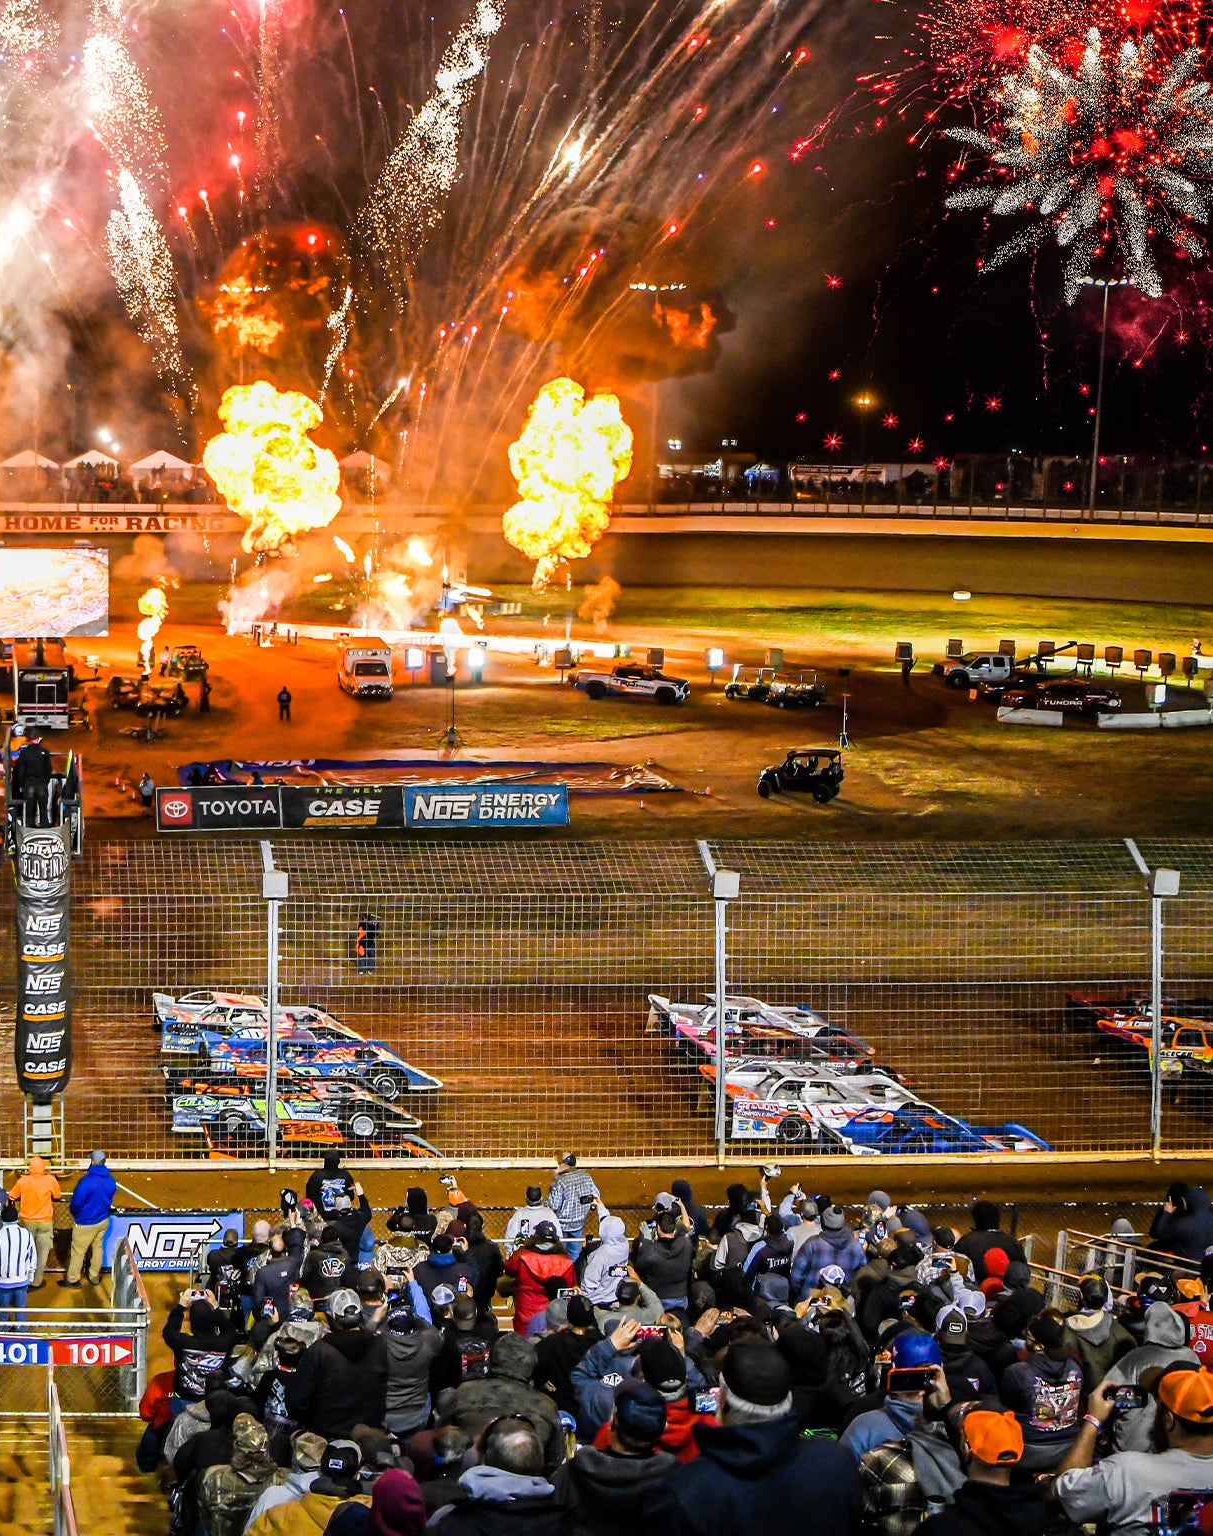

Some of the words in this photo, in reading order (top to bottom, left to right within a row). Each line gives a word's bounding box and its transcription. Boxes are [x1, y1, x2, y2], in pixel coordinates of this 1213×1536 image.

[5, 517, 81, 531] HOME
[89, 516, 119, 526] FOR
[125, 517, 224, 531] RACING
[413, 794, 476, 820] NOS
[481, 793, 561, 806] ENERGY
[199, 800, 277, 815] TOYOTA
[308, 800, 381, 816] CASE
[479, 806, 542, 819] DRINK
[26, 913, 63, 931] NOS
[23, 942, 65, 956] CASE
[26, 971, 64, 990] NOS
[24, 1000, 66, 1015] CASE
[26, 1029, 65, 1048] NOS
[1160, 1050, 1194, 1058] ACECAR
[24, 1058, 66, 1073] CASE
[128, 1219, 215, 1259] NOS
[69, 1343, 111, 1364] 101
